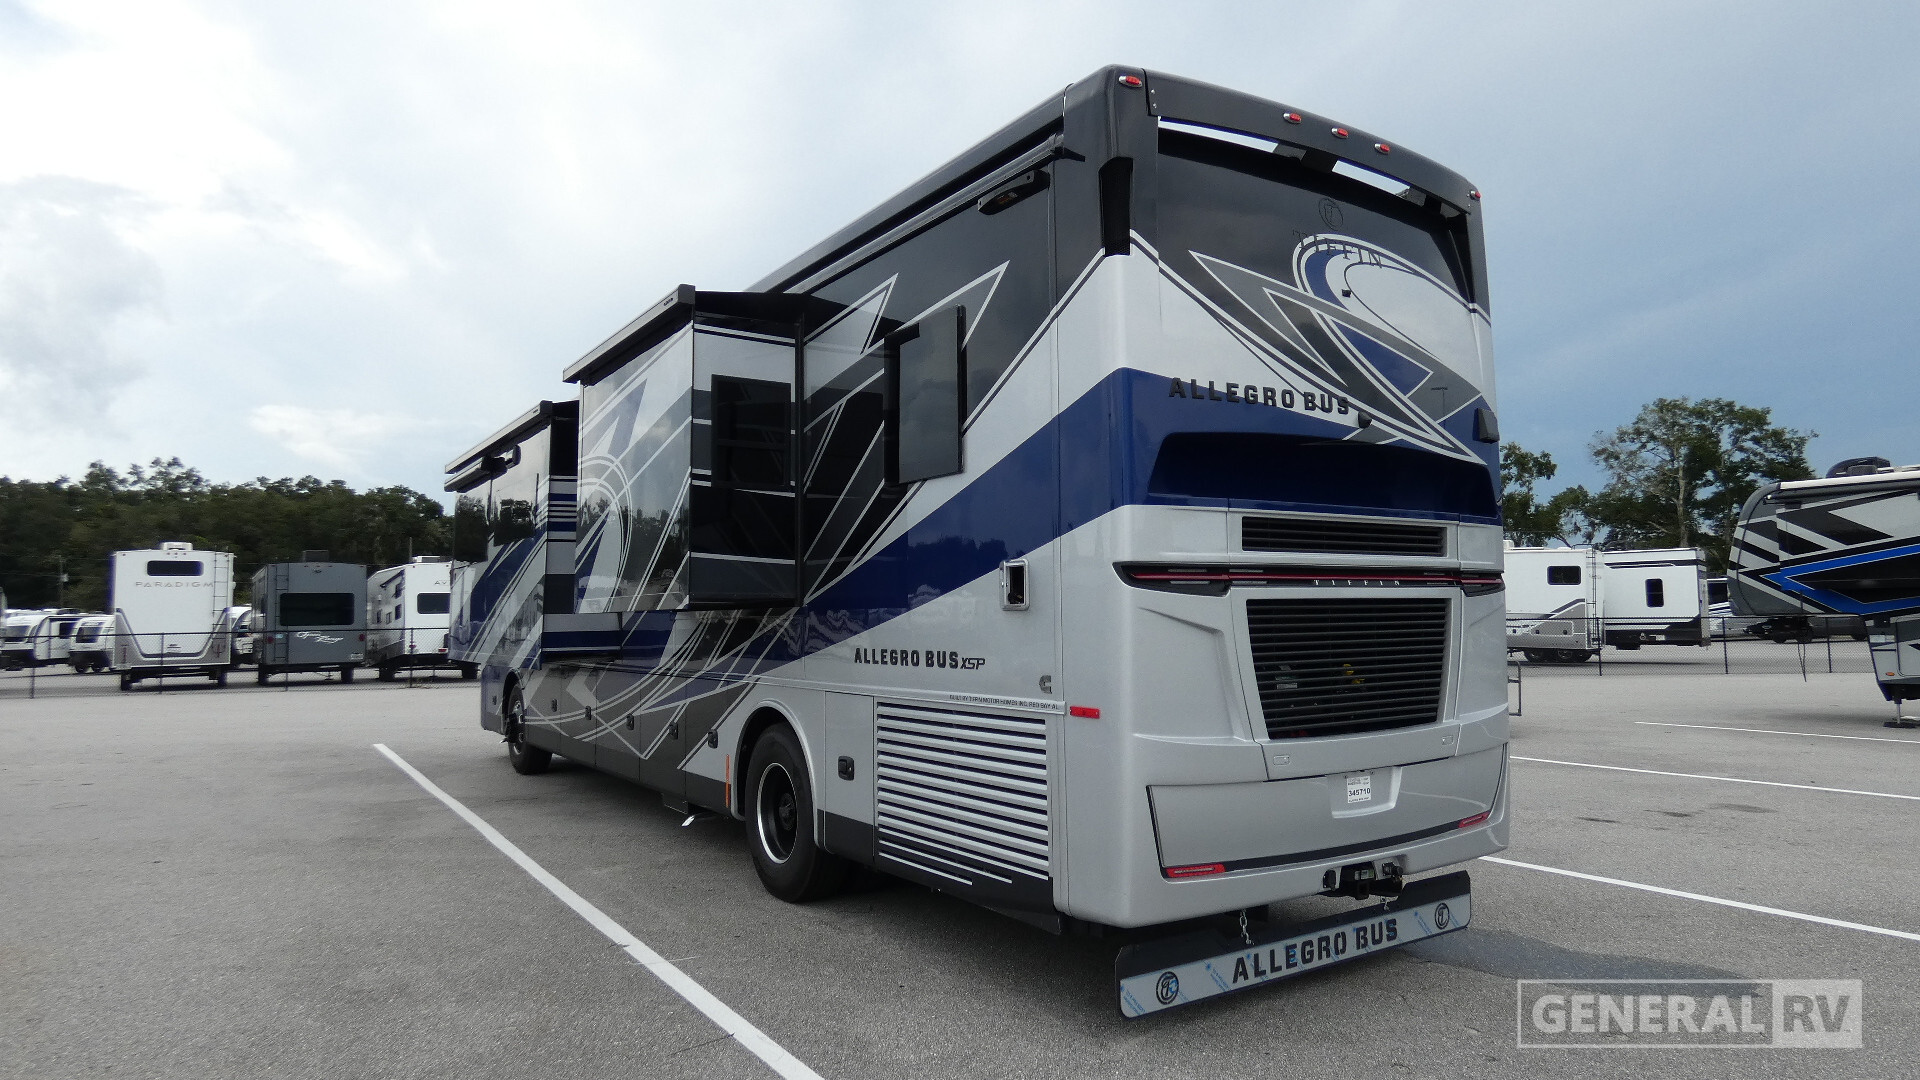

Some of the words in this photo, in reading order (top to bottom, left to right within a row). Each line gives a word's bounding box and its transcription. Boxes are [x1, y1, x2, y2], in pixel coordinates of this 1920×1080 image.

[1293, 229, 1383, 269] TIFFIN
[1168, 376, 1296, 408] ALLEGRO
[1303, 390, 1351, 416] BUS
[853, 647, 920, 667] ALLEGRO
[925, 649, 959, 670] BUS
[960, 656, 986, 670] XSP
[1232, 929, 1347, 984] ALLEGRO
[1355, 918, 1398, 950] BUS
